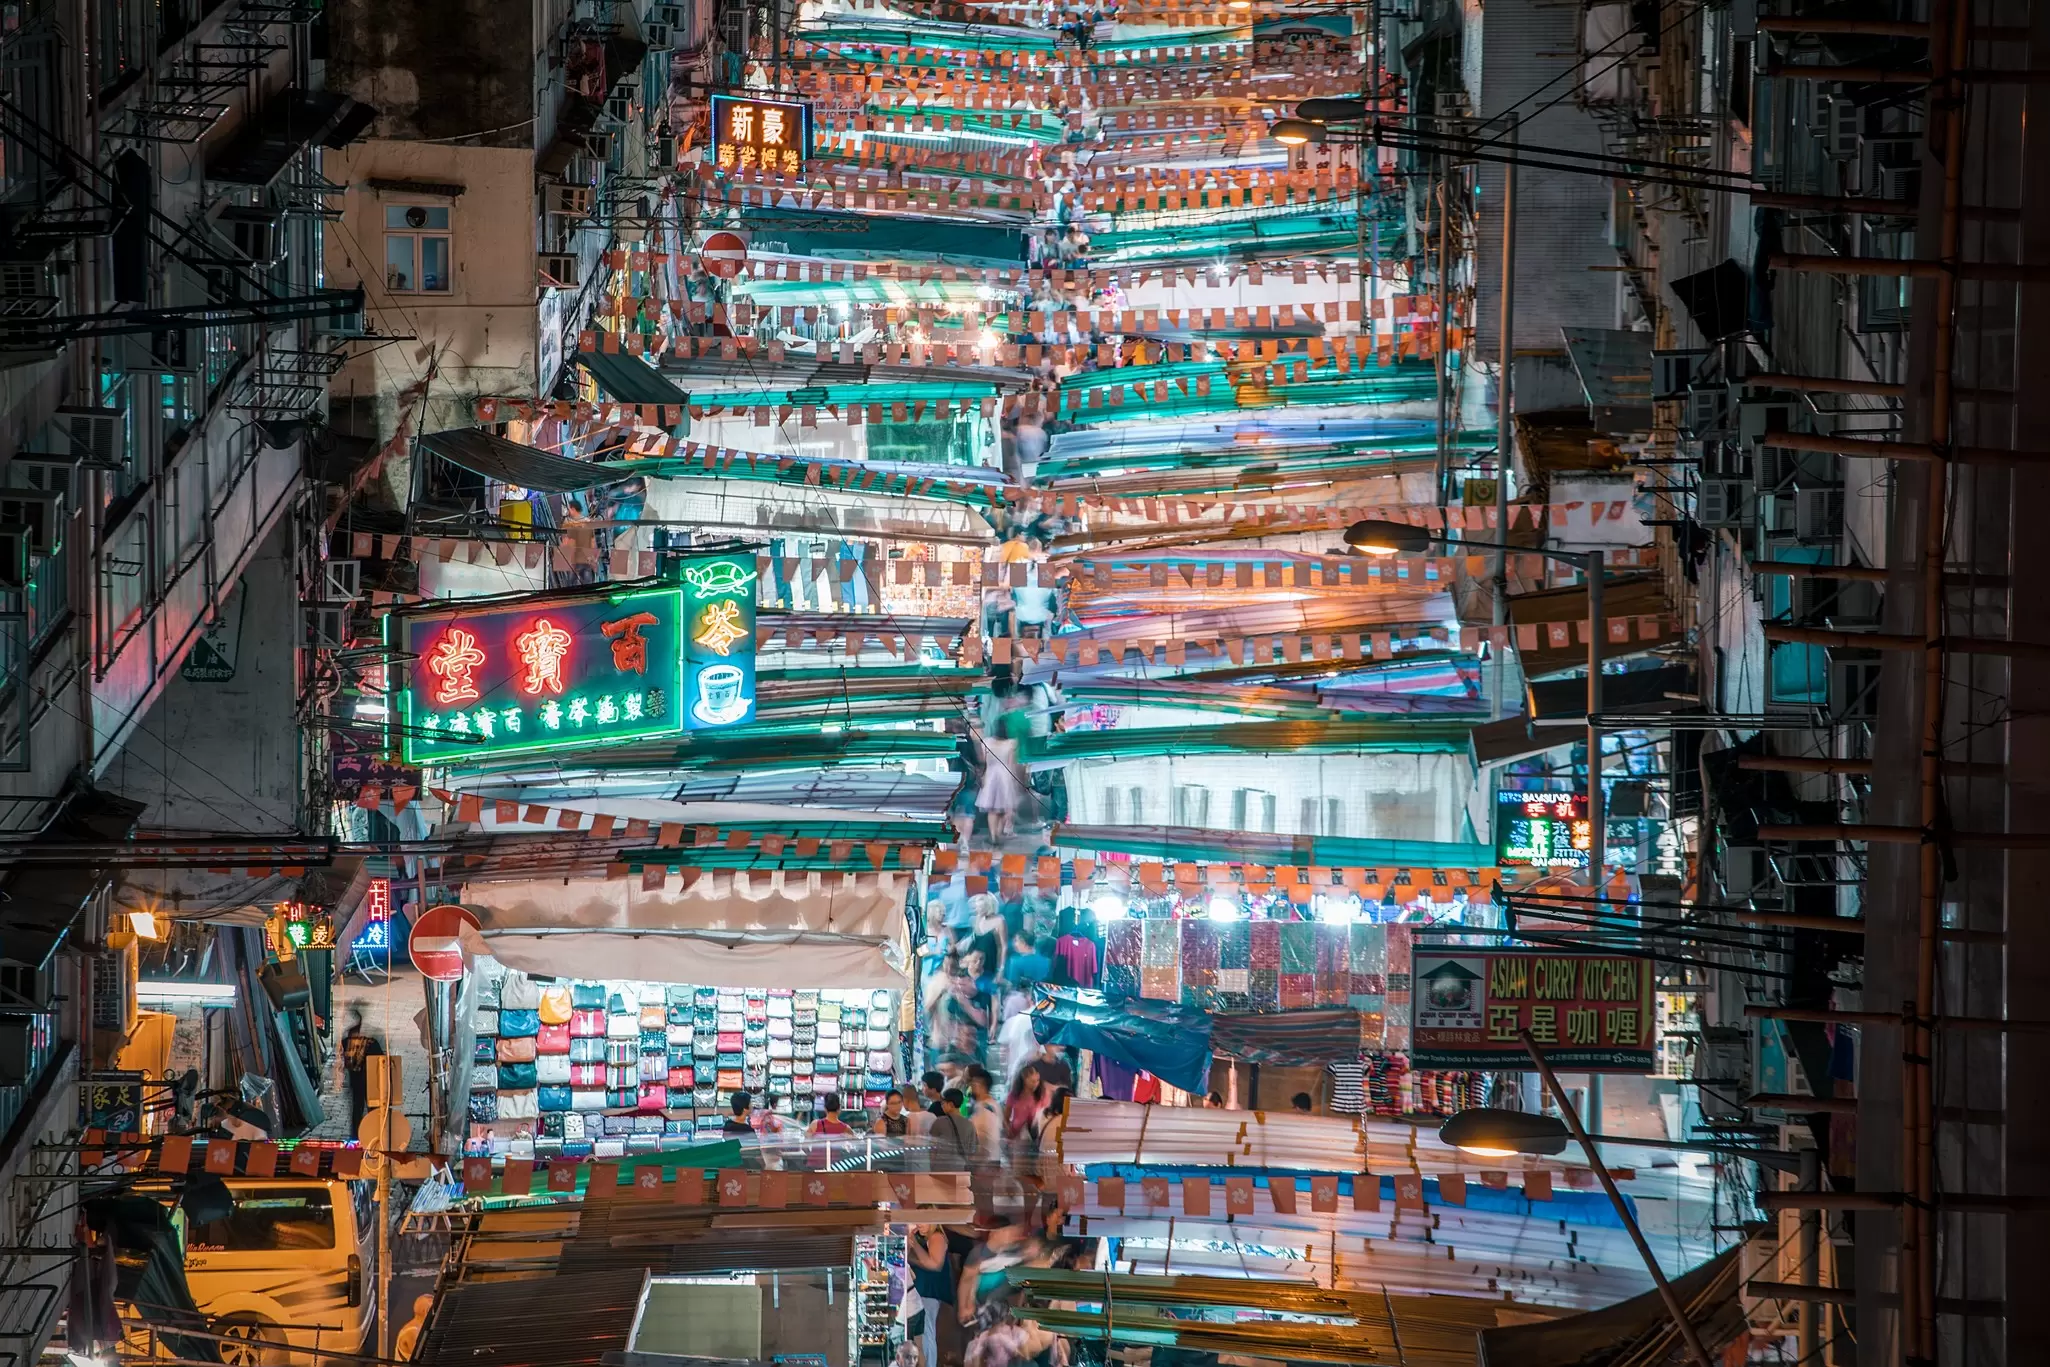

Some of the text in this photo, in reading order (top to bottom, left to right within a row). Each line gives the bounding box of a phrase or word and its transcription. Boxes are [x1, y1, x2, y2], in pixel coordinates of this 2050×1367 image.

[732, 105, 784, 145] 新豪
[1522, 792, 1571, 803] SAMSUNG
[1488, 958, 1638, 1001] ASIAN CURRY KITCHEN
[1487, 1004, 1639, 1045] 亞星咖喱
[115, 1111, 129, 1126] 24
